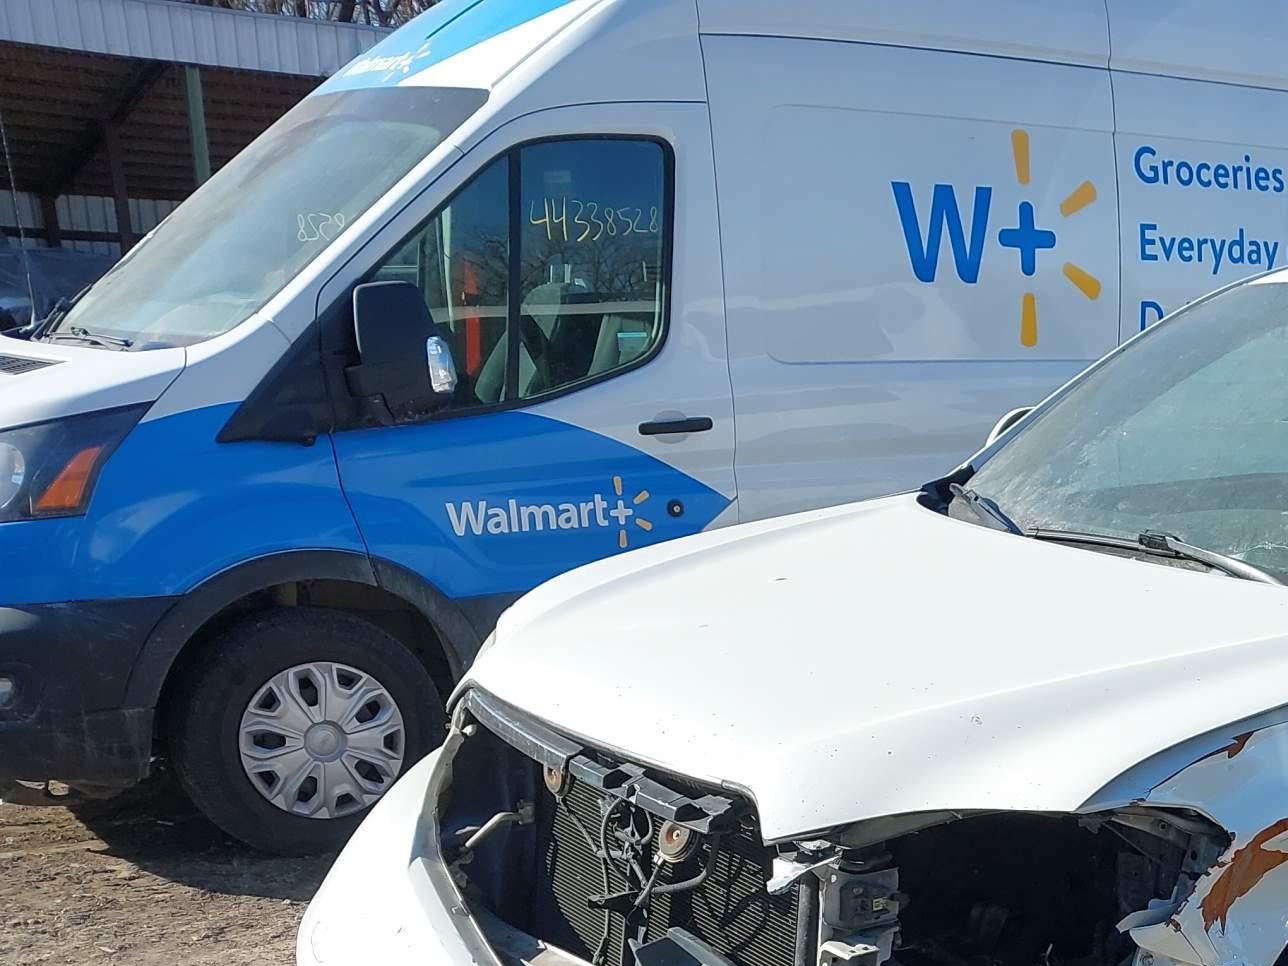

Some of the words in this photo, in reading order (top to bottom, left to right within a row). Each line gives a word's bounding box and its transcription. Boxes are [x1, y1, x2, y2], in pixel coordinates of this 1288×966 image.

[1134, 146, 1285, 193] Groceries
[529, 196, 658, 242] 44338528
[1139, 223, 1278, 275] Everyday
[445, 494, 633, 536] Walmart+
